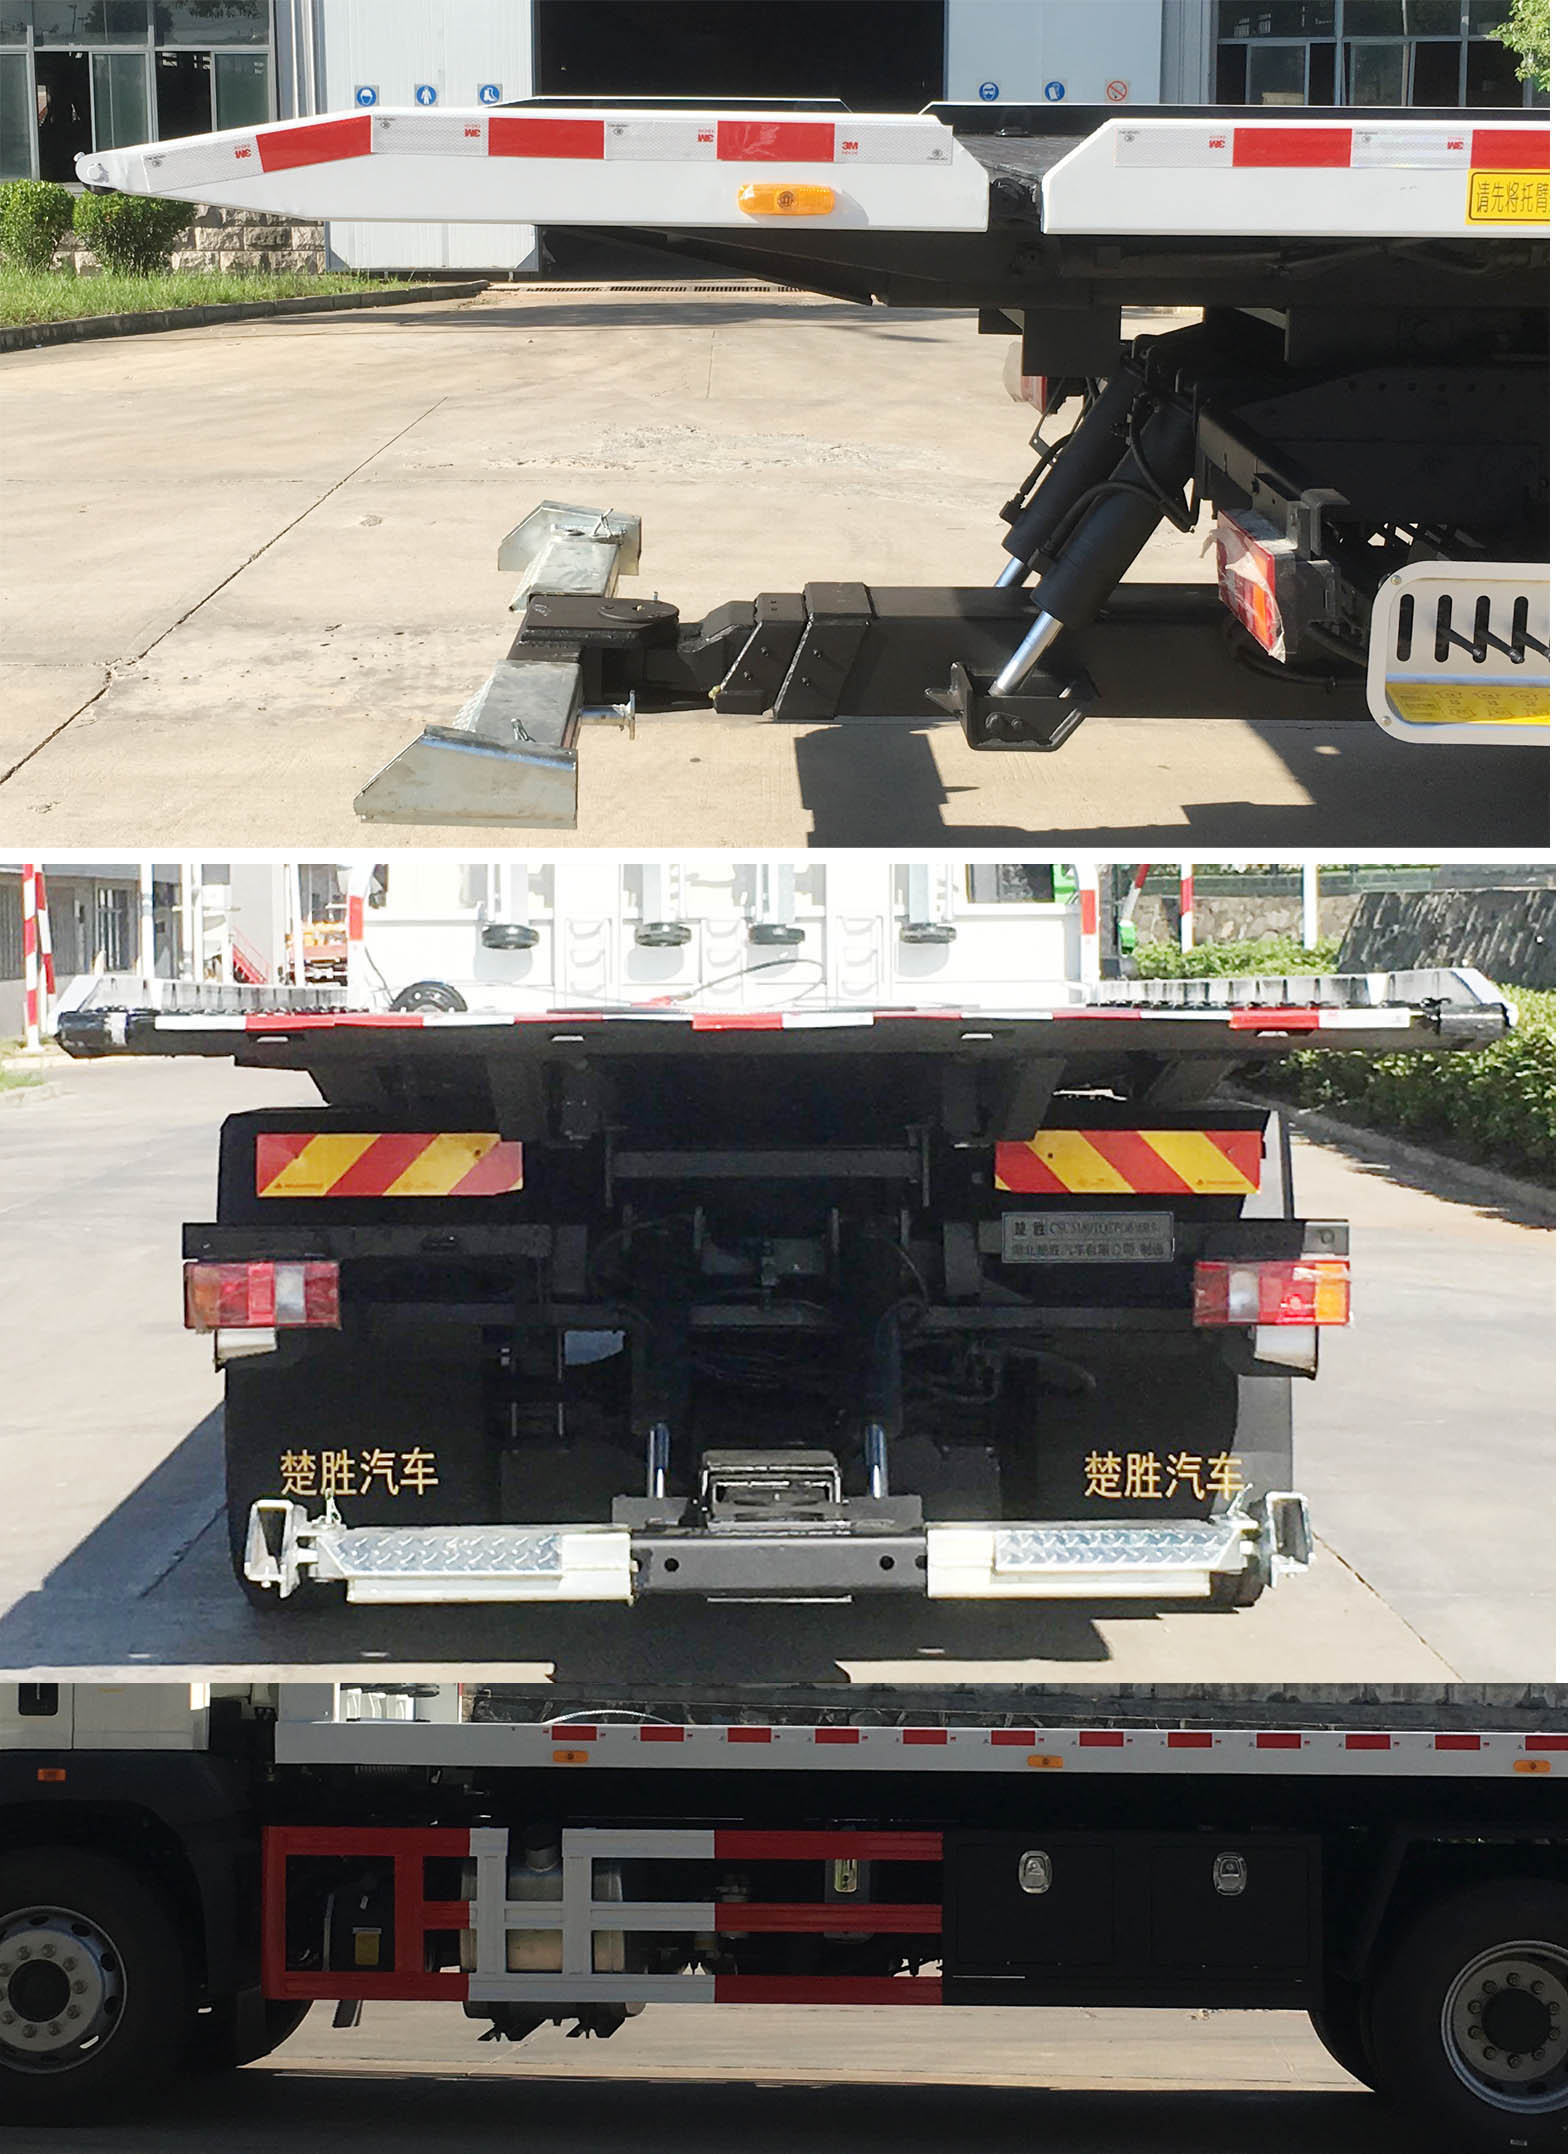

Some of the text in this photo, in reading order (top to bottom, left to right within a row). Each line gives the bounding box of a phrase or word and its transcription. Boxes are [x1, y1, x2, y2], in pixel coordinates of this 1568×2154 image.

[842, 141, 859, 150] 3M
[1476, 182, 1549, 213] 请先将托臂
[280, 1447, 439, 1496] 楚胜汽车
[1084, 1450, 1245, 1500] 楚胜汽车
